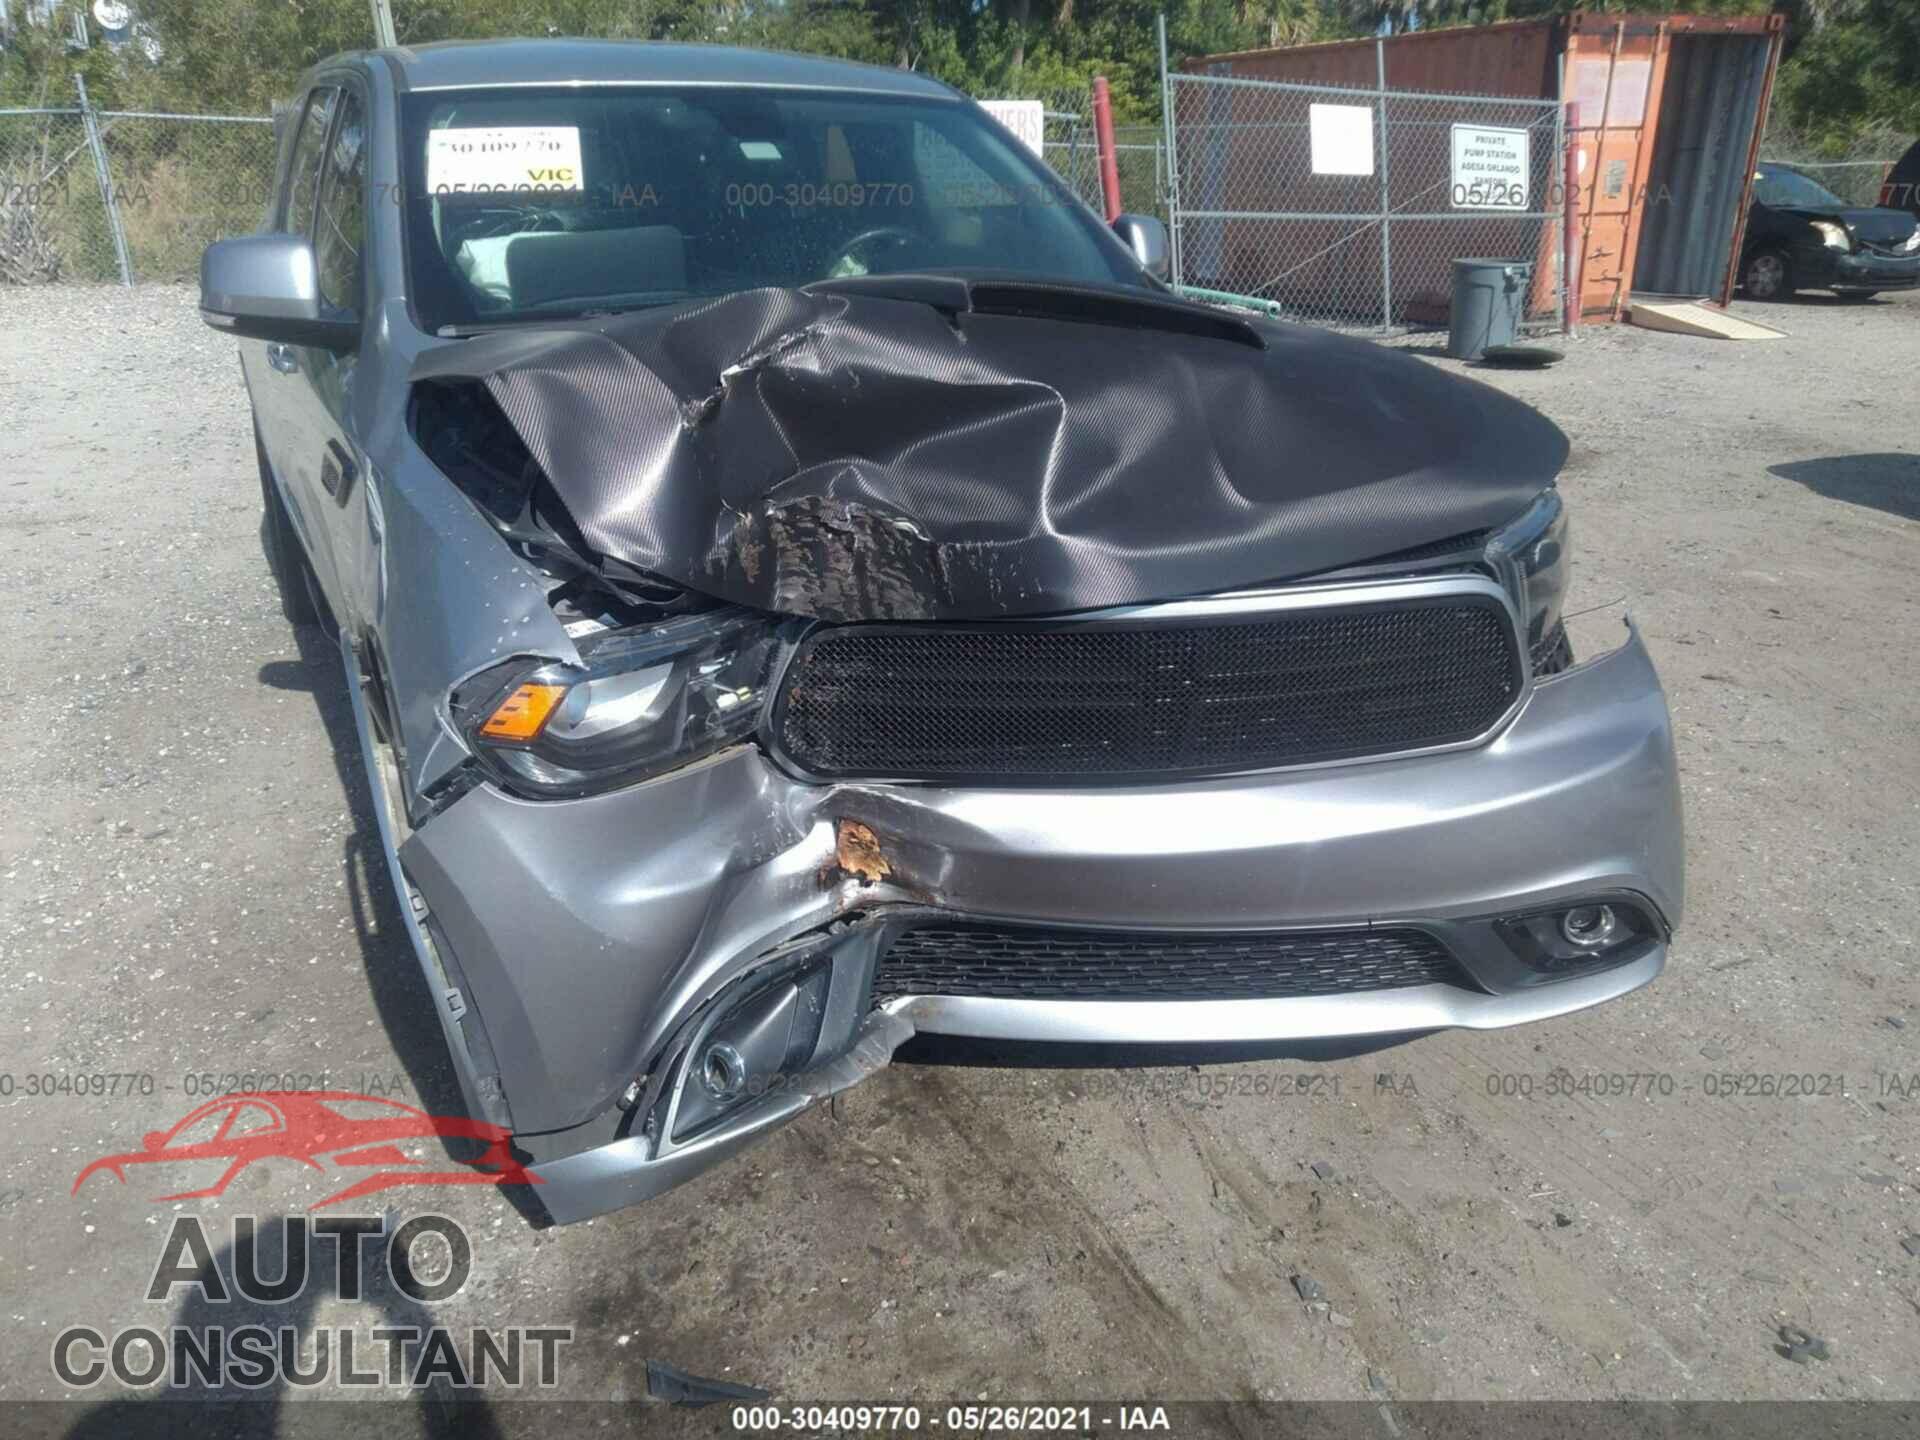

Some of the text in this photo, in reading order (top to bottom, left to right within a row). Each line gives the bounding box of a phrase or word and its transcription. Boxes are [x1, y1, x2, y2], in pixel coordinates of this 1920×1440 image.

[1475, 135, 1506, 146] PRIVATE
[1464, 148, 1517, 160] PUMP STATION
[1487, 164, 1520, 174] ORLANDO
[527, 169, 573, 181] VIC
